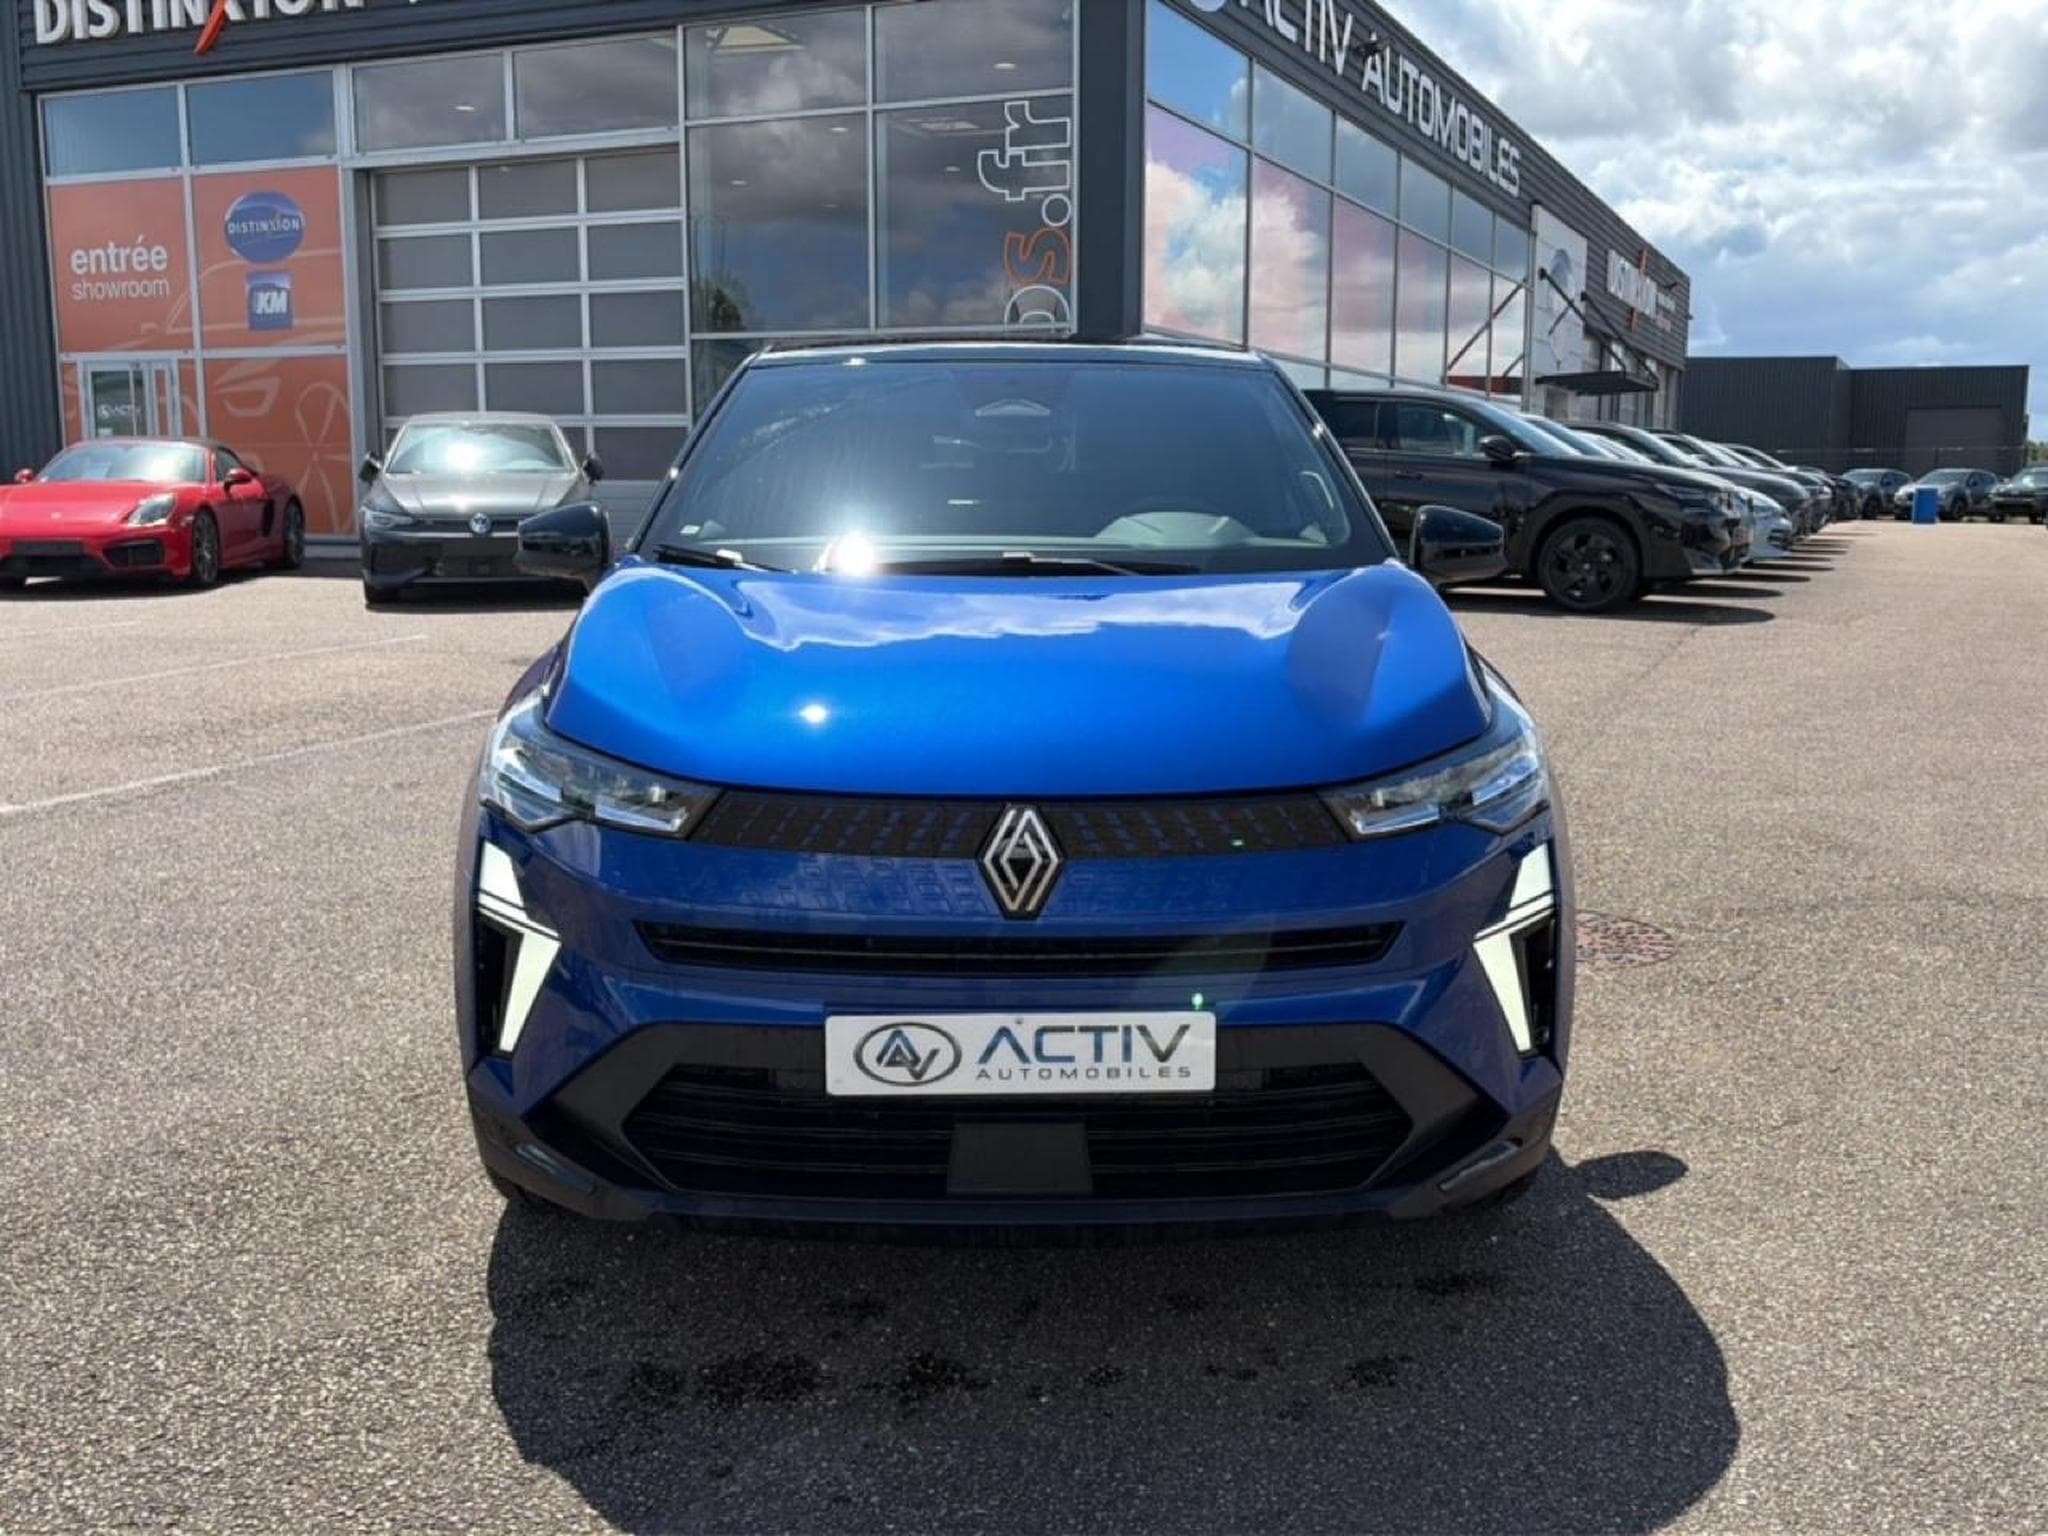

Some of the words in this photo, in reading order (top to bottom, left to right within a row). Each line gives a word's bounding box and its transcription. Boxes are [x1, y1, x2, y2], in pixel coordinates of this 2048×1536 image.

[36, 0, 364, 53] DISTINX
[1361, 31, 1521, 198] AUTOMOBILES
[71, 233, 168, 275] entrée
[72, 279, 170, 301] showroom
[976, 1024, 1191, 1065] ACTIV
[975, 1066, 1191, 1081] AUTOMOBILES
